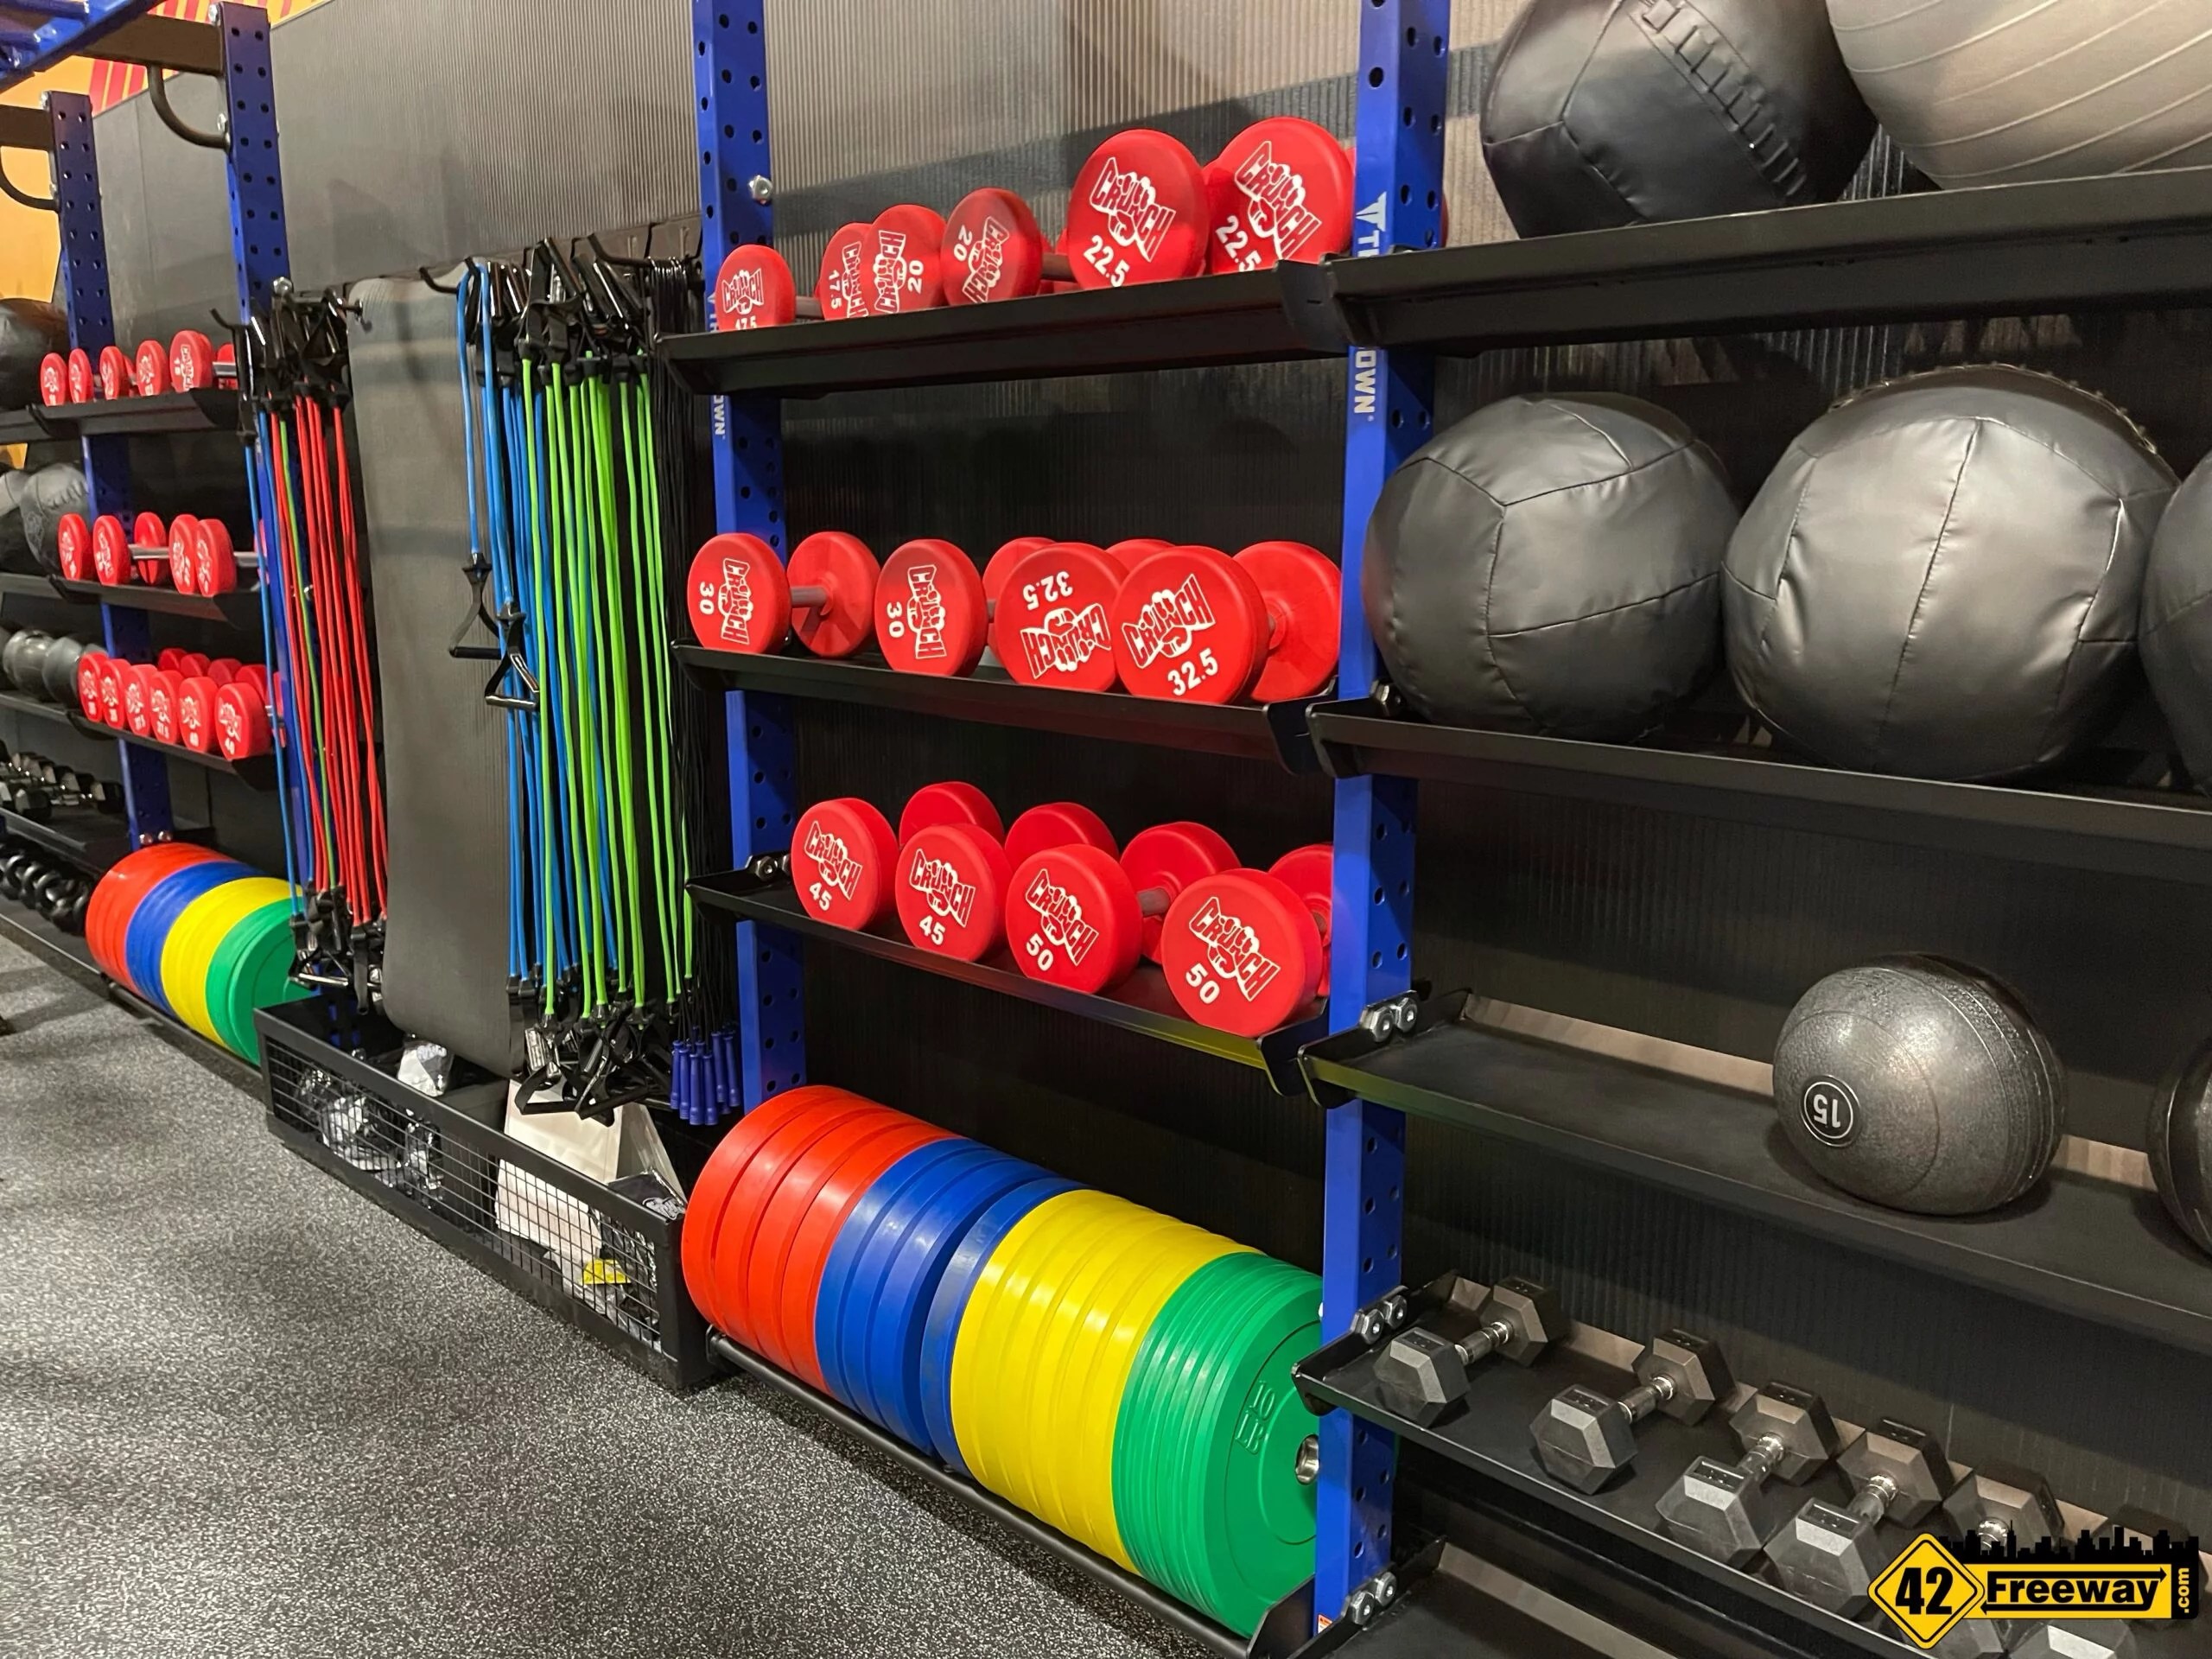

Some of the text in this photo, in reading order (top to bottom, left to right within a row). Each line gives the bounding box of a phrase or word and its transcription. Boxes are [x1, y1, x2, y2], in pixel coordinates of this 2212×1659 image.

[1090, 157, 1176, 262] CRUNCH
[1235, 141, 1322, 259] CRUNCH
[954, 225, 972, 261] 20
[962, 216, 1009, 303] CRUNCH
[1083, 235, 1129, 287] 22.5
[1216, 215, 1262, 271] 22.5
[722, 267, 764, 314] CRUNCH
[828, 270, 842, 309] 17.5
[873, 229, 906, 314] CRUNCH
[907, 260, 924, 294] 20
[1354, 346, 1376, 414] OWN
[699, 582, 715, 615] 30
[718, 558, 753, 645] CRUNCH
[907, 564, 947, 659] CRUNCH
[1023, 571, 1073, 610] 32.5
[887, 601, 905, 638] 30
[1020, 603, 1111, 679] CRUNCH
[1122, 573, 1216, 669] CRUNCH
[1167, 648, 1219, 696] 32.5
[804, 820, 863, 900] CRUNCH
[809, 882, 832, 911] 45
[909, 849, 976, 928] CRUNCH
[919, 915, 946, 945] 45
[1026, 868, 1099, 966] CRUNCH
[1026, 933, 1054, 971] 50
[1189, 896, 1281, 1002] CRUNCH
[1185, 963, 1220, 1004] 50
[1813, 1093, 1841, 1128] 15
